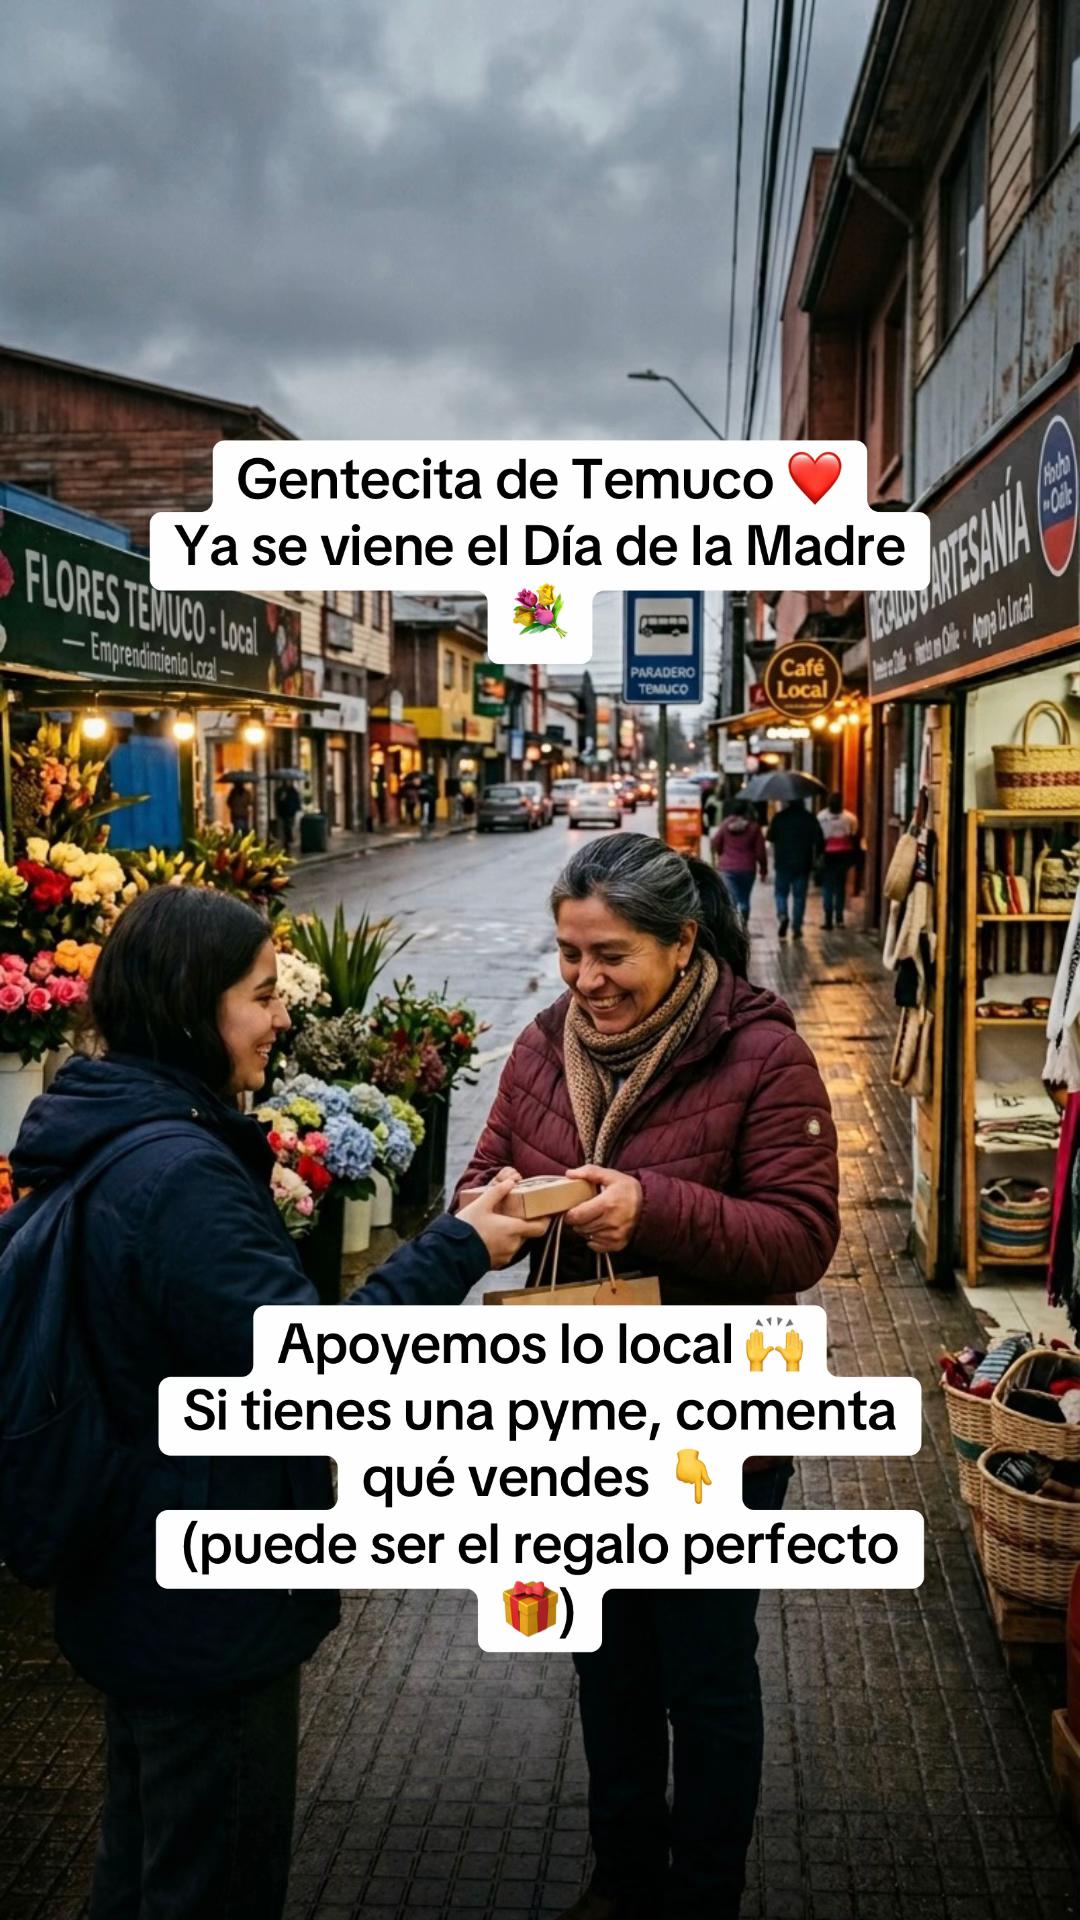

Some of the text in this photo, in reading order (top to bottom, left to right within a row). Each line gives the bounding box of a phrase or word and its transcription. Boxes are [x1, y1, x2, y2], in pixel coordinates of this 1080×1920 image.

[931, 465, 1031, 609] ARTESANÍA
[25, 549, 120, 624] FLORES
[124, 580, 206, 644] TEMUCO
[220, 609, 258, 656] Local
[630, 666, 696, 679] PARADERO
[780, 657, 826, 677] Café
[638, 683, 689, 695] TEMUCO
[777, 680, 828, 698] Local
